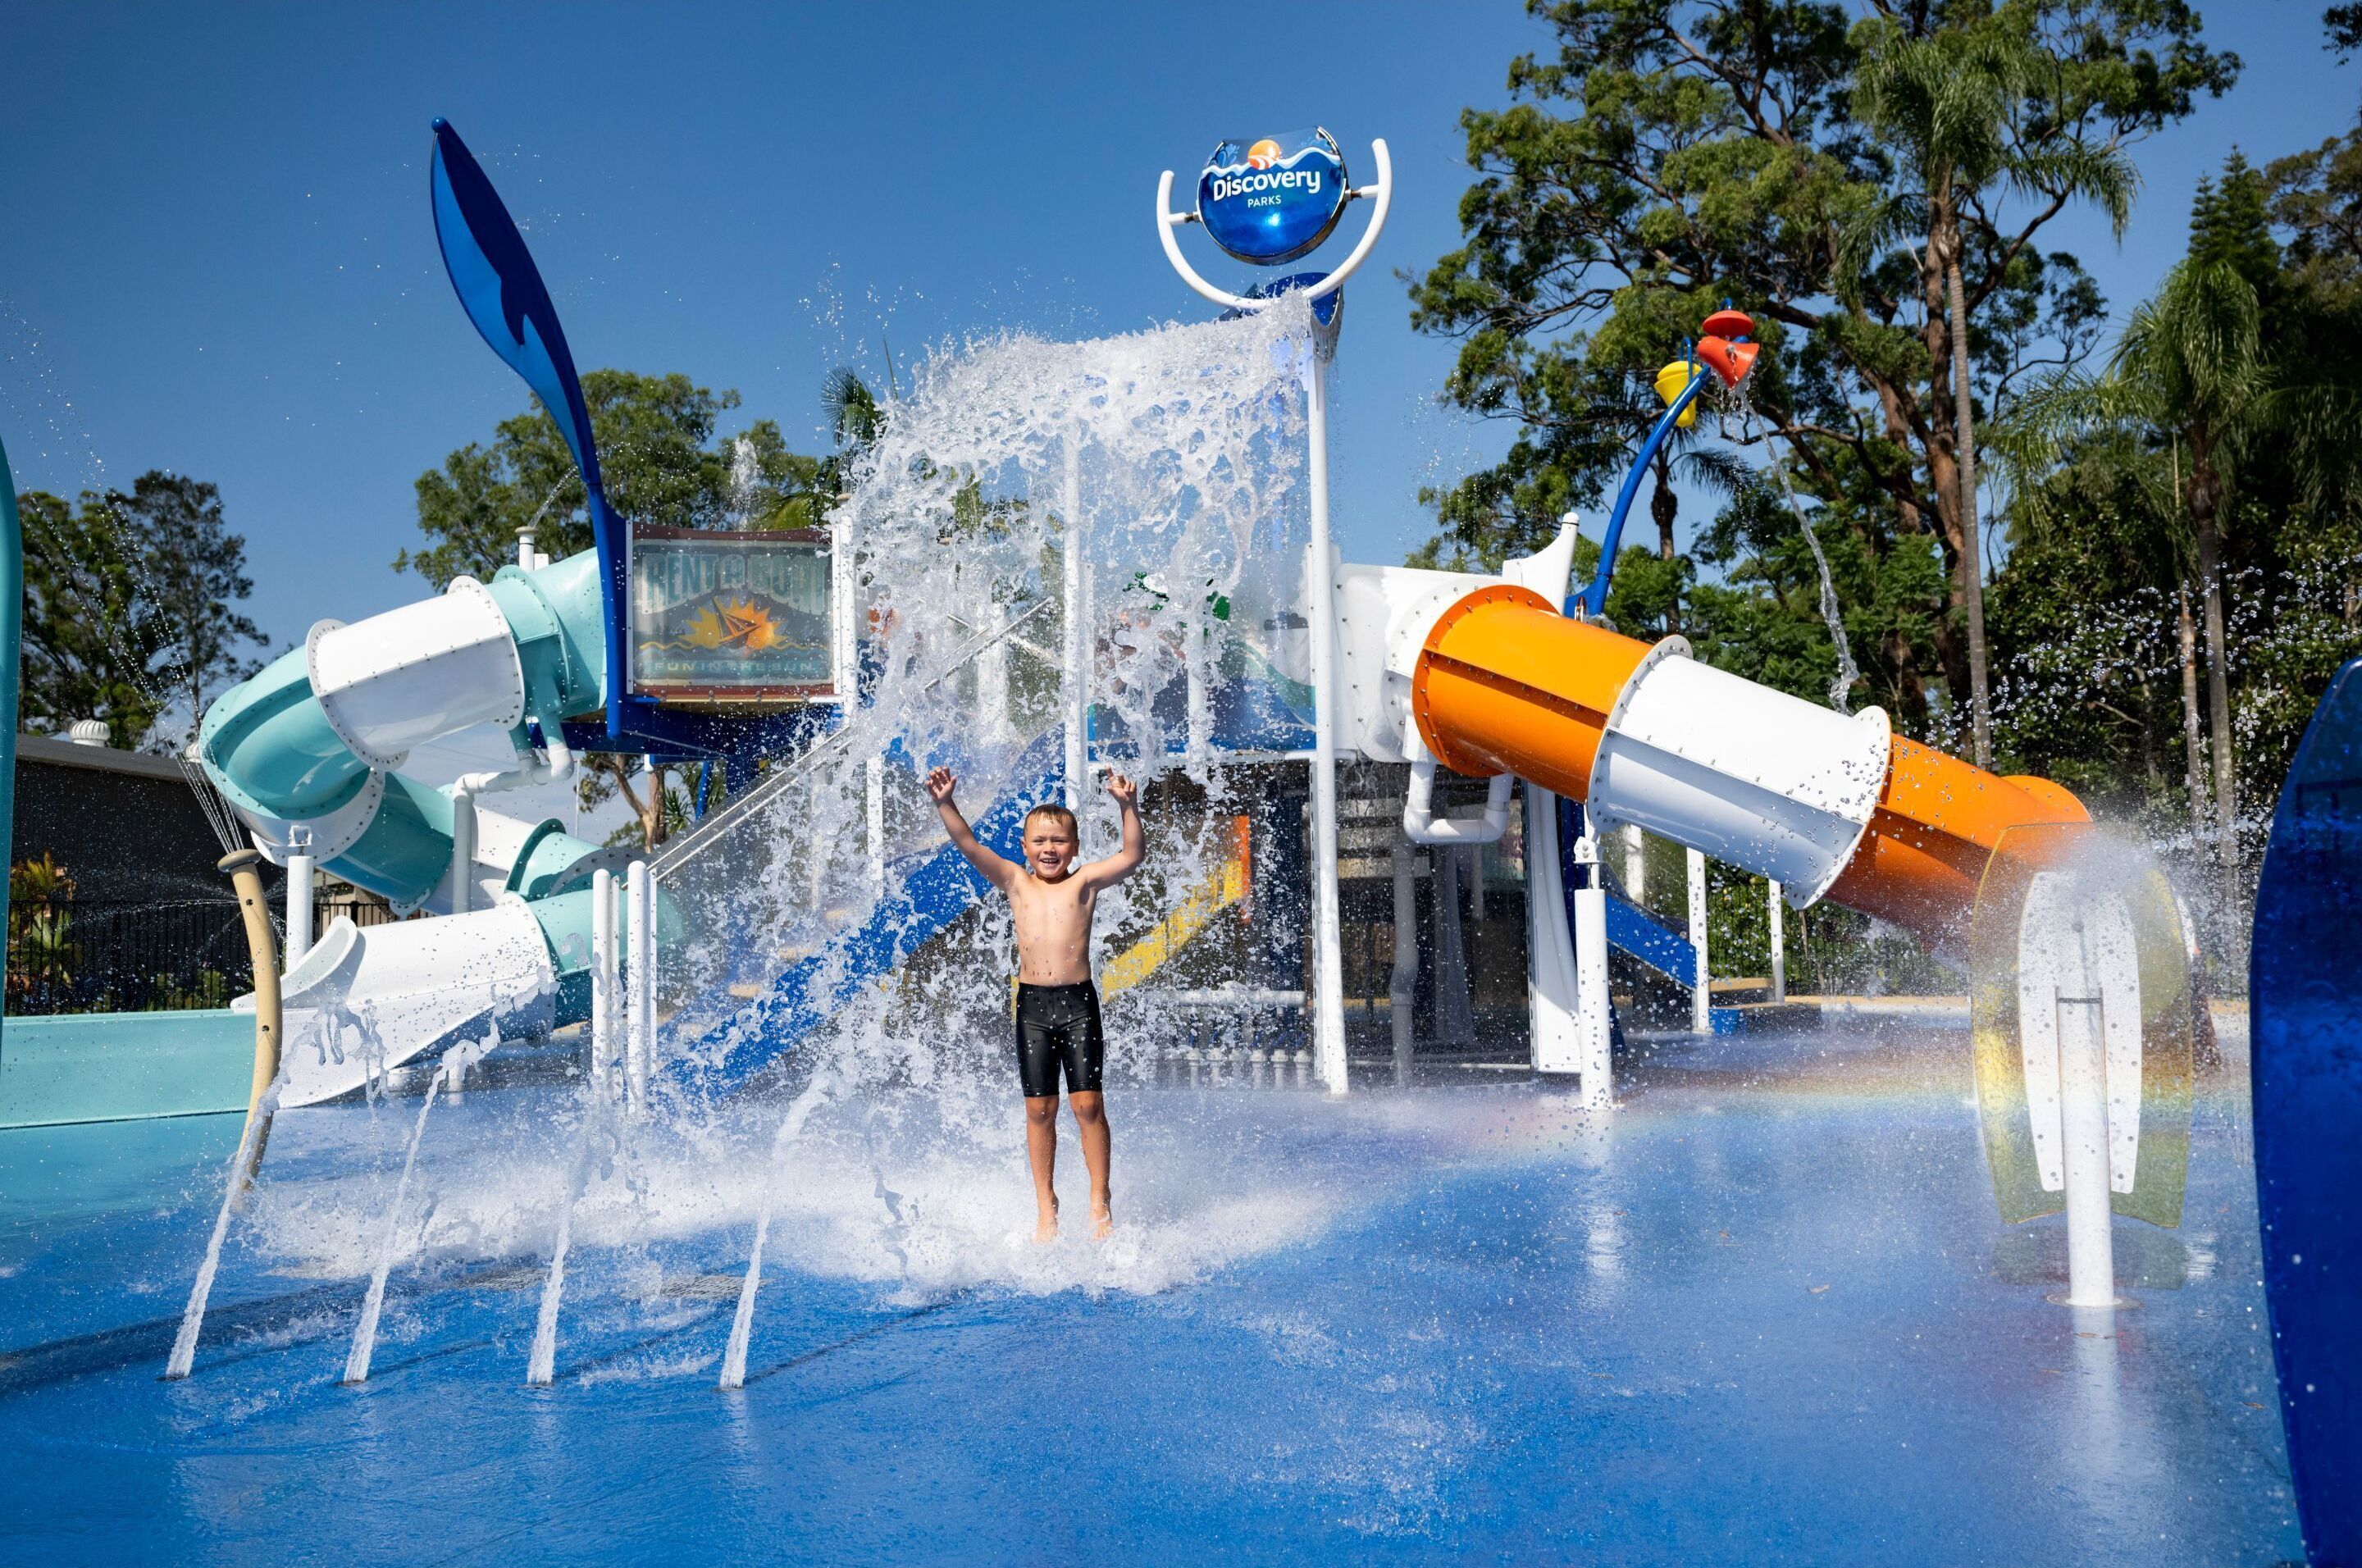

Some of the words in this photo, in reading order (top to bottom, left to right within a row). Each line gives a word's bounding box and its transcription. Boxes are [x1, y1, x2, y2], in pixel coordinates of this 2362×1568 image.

[1213, 171, 1320, 202] Discovery
[1247, 194, 1282, 208] PARKS
[641, 553, 718, 614] RENT
[719, 554, 746, 589] A
[654, 661, 695, 672] FUN
[700, 661, 722, 672] IN
